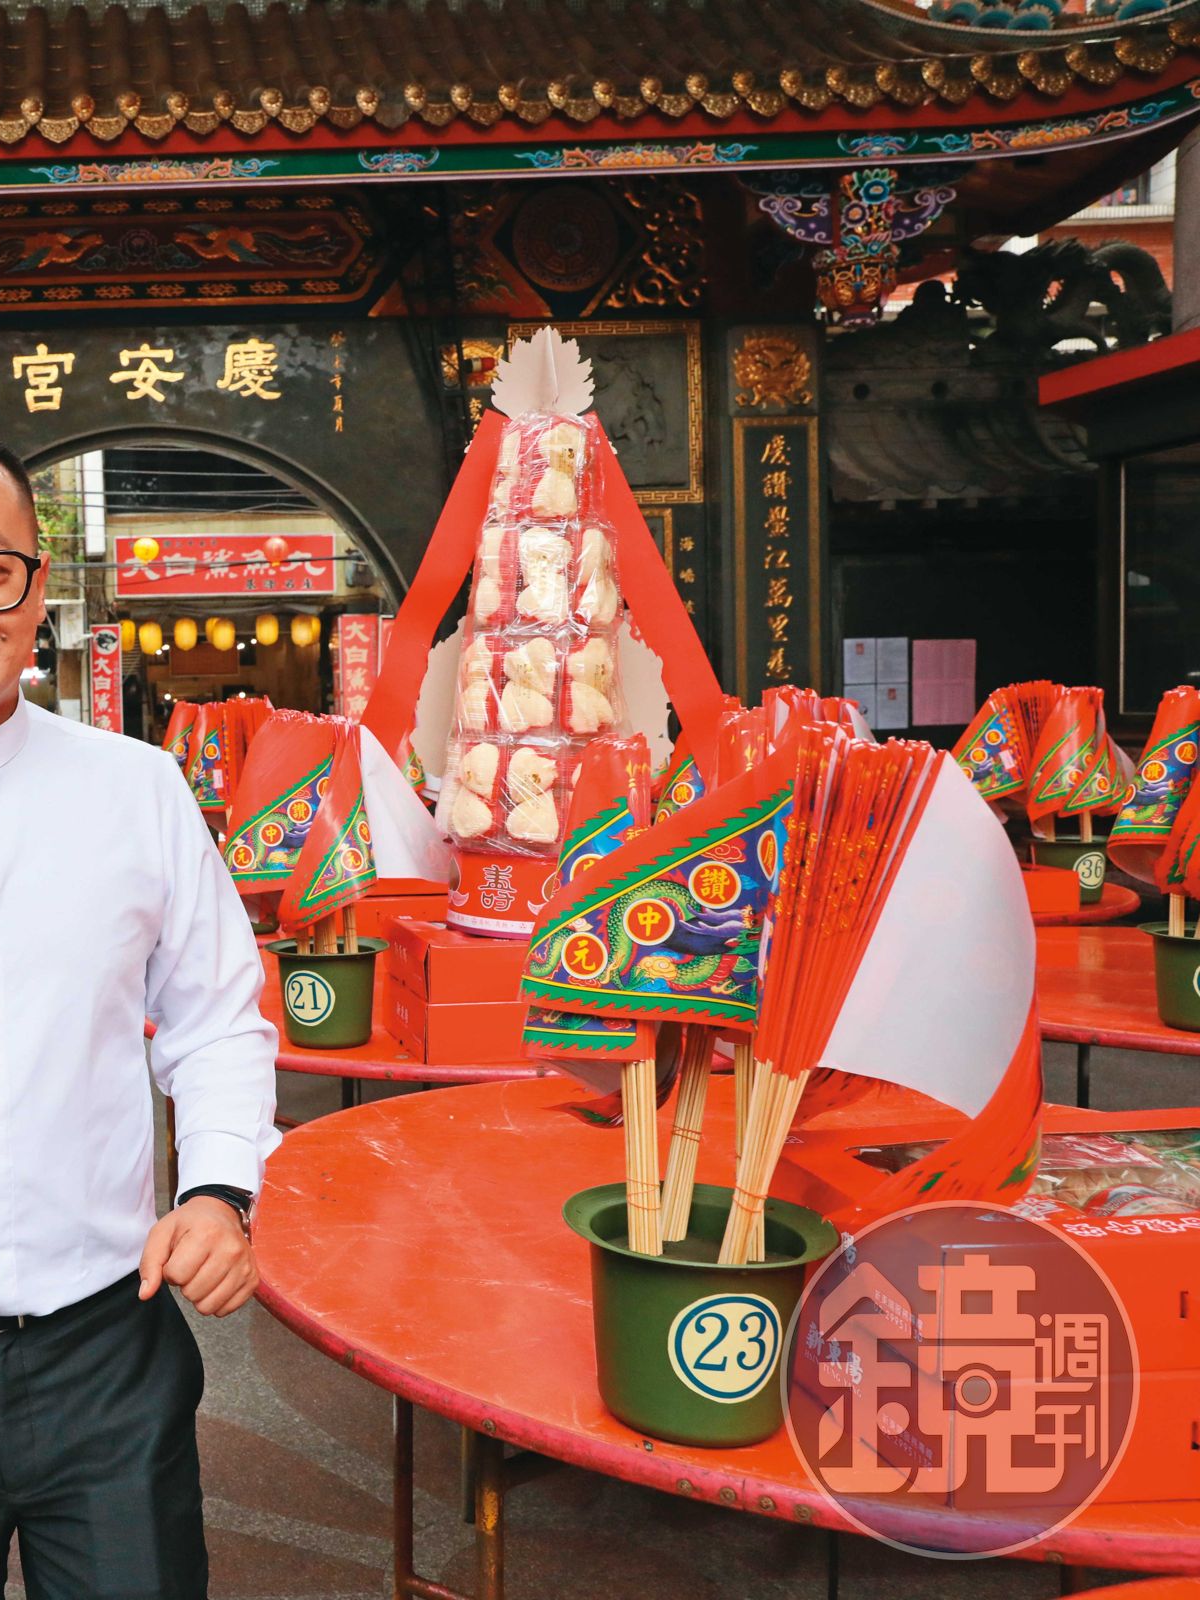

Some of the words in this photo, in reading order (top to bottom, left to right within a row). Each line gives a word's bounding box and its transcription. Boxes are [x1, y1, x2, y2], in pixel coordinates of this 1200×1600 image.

[344, 621, 371, 725] 大白鯊魚
[1081, 857, 1104, 880] 36
[290, 979, 323, 1011] 21
[691, 1309, 768, 1373] 23
[807, 1320, 863, 1386] 新東陽
